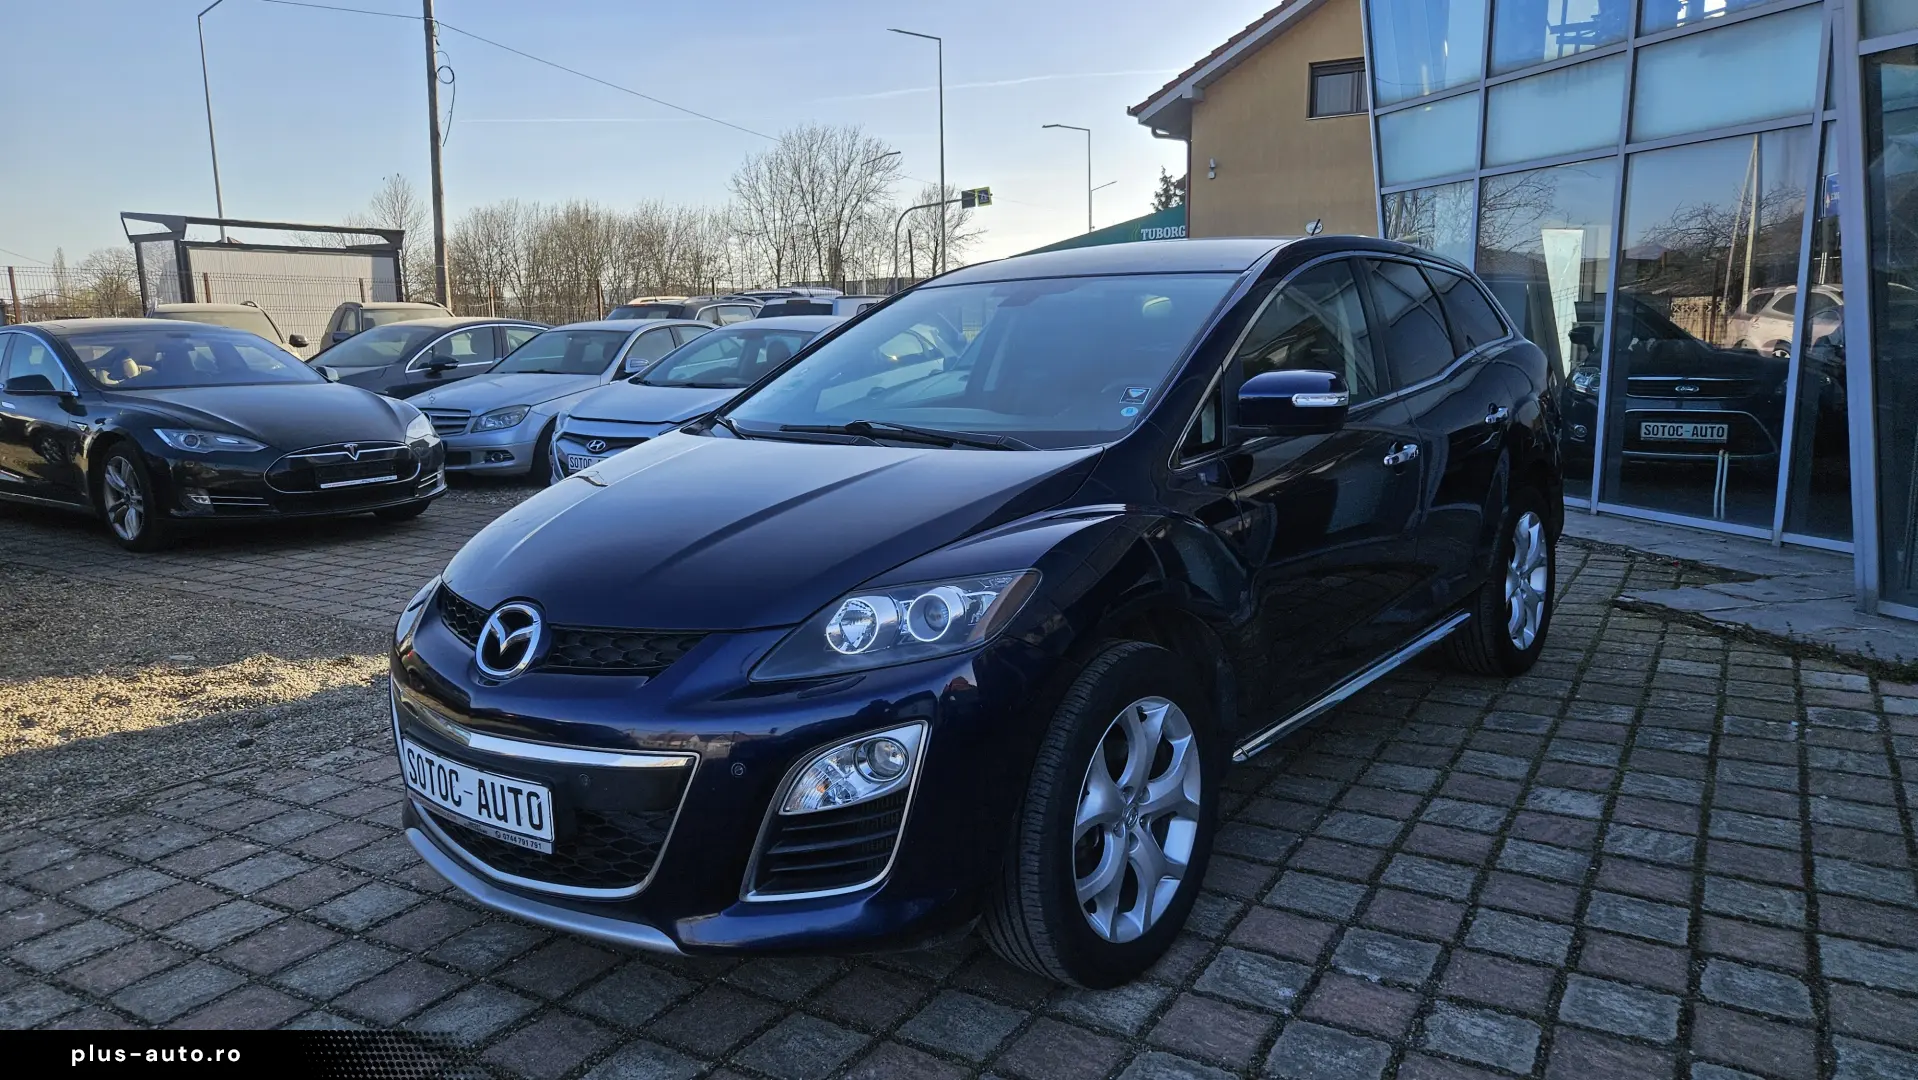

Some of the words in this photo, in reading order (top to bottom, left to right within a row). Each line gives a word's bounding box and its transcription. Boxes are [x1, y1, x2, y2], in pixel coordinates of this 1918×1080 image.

[1141, 225, 1186, 240] TUBORG
[1643, 424, 1725, 438] SOTOC-AUTO
[570, 456, 601, 469] SOTOC
[407, 748, 544, 831] SOTOC-AUTO
[530, 841, 542, 850] 791
